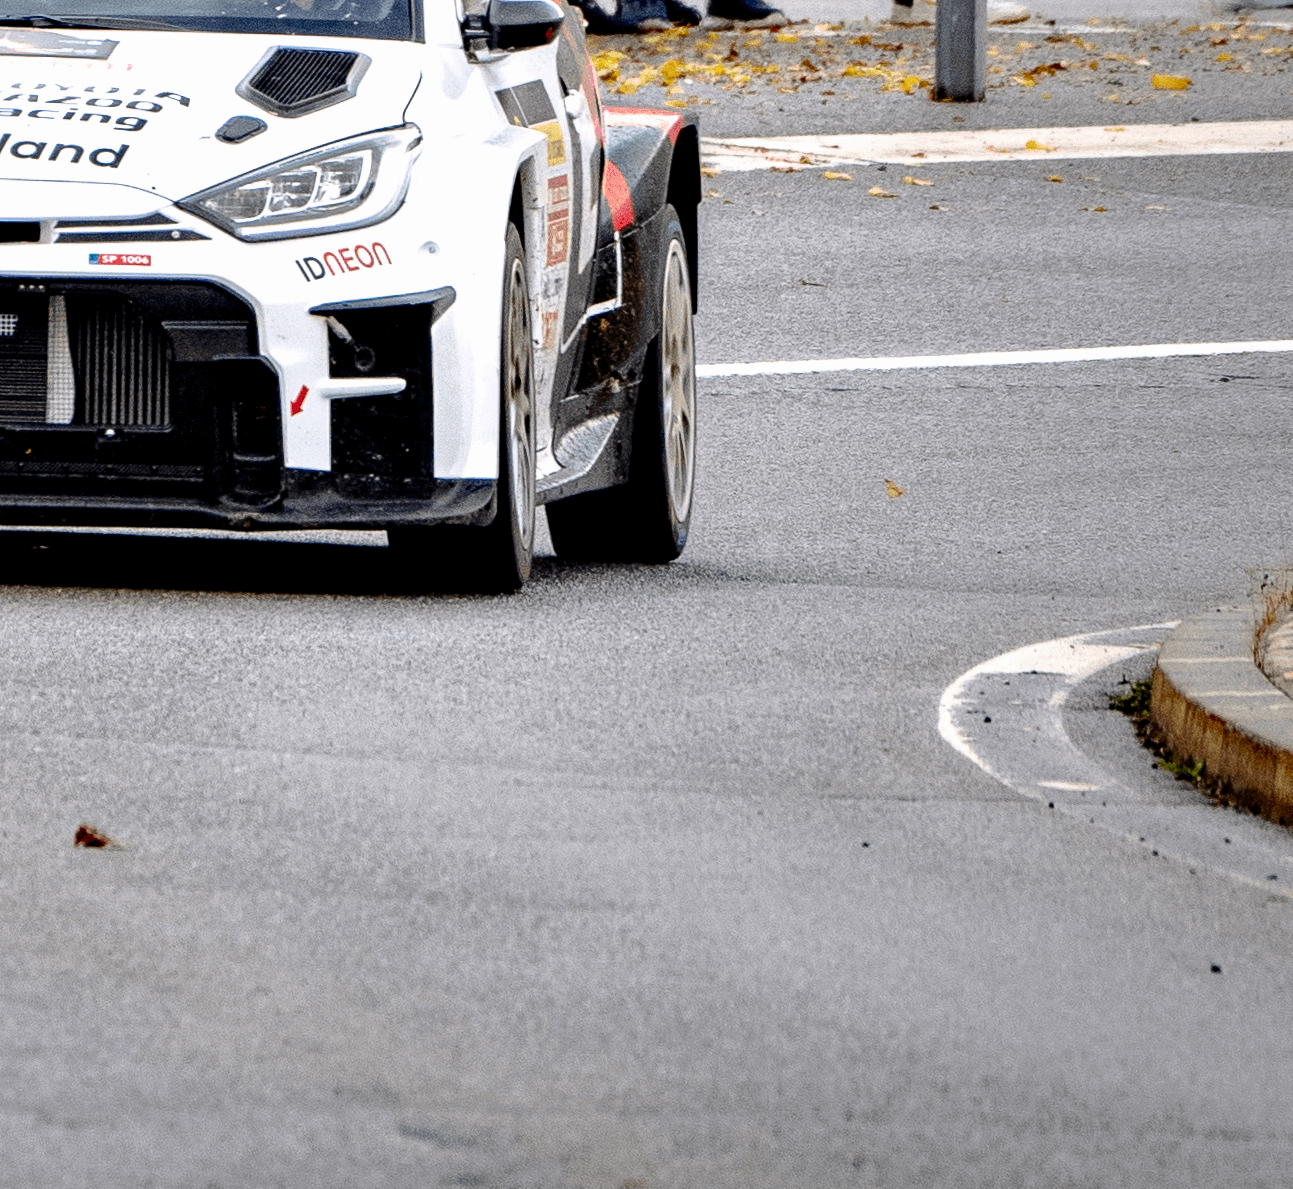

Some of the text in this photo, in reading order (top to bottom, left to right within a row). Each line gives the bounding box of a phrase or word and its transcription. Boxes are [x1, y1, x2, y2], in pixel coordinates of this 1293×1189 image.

[102, 255, 149, 264] SP 1006
[295, 242, 392, 282] IDNEON
